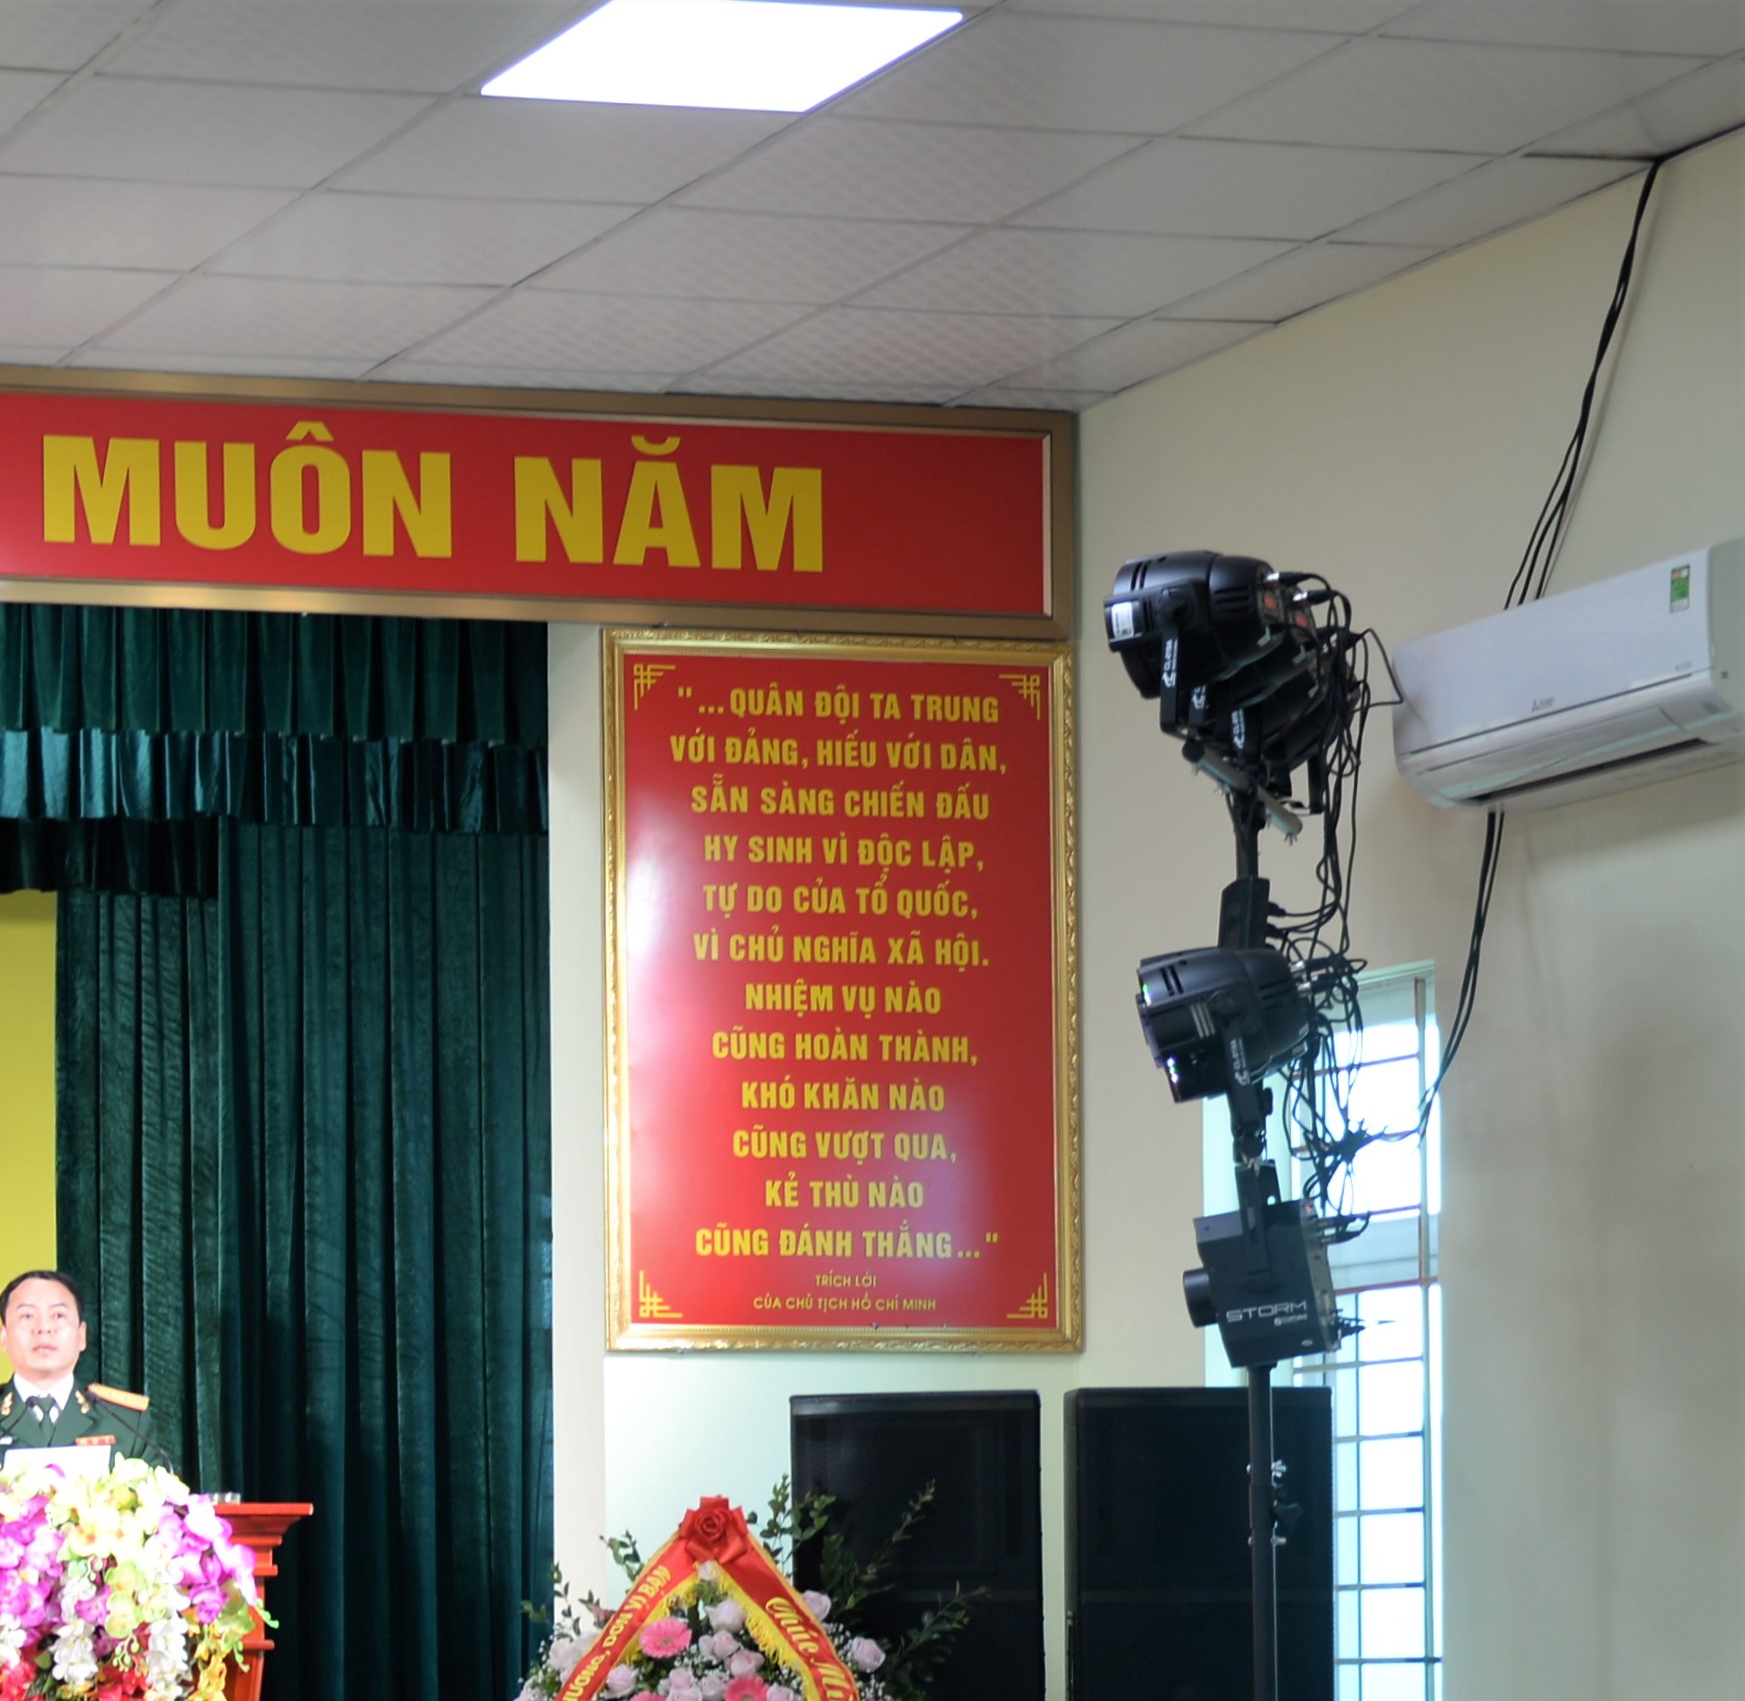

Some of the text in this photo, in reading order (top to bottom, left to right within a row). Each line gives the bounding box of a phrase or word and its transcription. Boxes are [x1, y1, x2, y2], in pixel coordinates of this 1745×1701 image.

[43, 421, 452, 558] MUÔN
[514, 435, 823, 572] NĂM
[815, 684, 860, 724] ĐỘI
[870, 692, 901, 720] TA
[912, 695, 999, 724] TRUNG
[670, 727, 1007, 775] VỚI ĐẢNG, HIẾU VỚI DÂN,
[691, 772, 990, 821] SẴN SÀNG CHIẾN ĐẤU
[704, 832, 985, 874] HY SINH VÌ ĐỘC LẬP,
[703, 872, 979, 920] TỰ DO CỦA TỔ QUỐC,
[693, 924, 990, 973] VÌ CHỦ NGHĨA XÃ HỘI.
[745, 978, 942, 1019] NHIỆM VỤ NÀO
[712, 1026, 979, 1068] CŨNG HOÀN THÀNH,
[741, 1074, 945, 1112] KHÓ KHĂN NÀO
[732, 1124, 957, 1165] CŨNG VƯỢT QUA,
[765, 1170, 925, 1210] KẺ THÙ NÀO
[695, 1221, 769, 1257] CŨNG
[779, 1223, 853, 1258] ĐÁNH
[815, 1271, 877, 1288] TRÍCH LỜI
[752, 1293, 783, 1310] CỦA
[785, 1292, 813, 1311] CHỦ
[817, 1296, 847, 1314] TỊCH
[876, 1293, 900, 1311] CHÍ
[902, 1298, 937, 1311] MINH
[1226, 1300, 1307, 1322] STORM
[765, 1597, 820, 1655] Chúc
